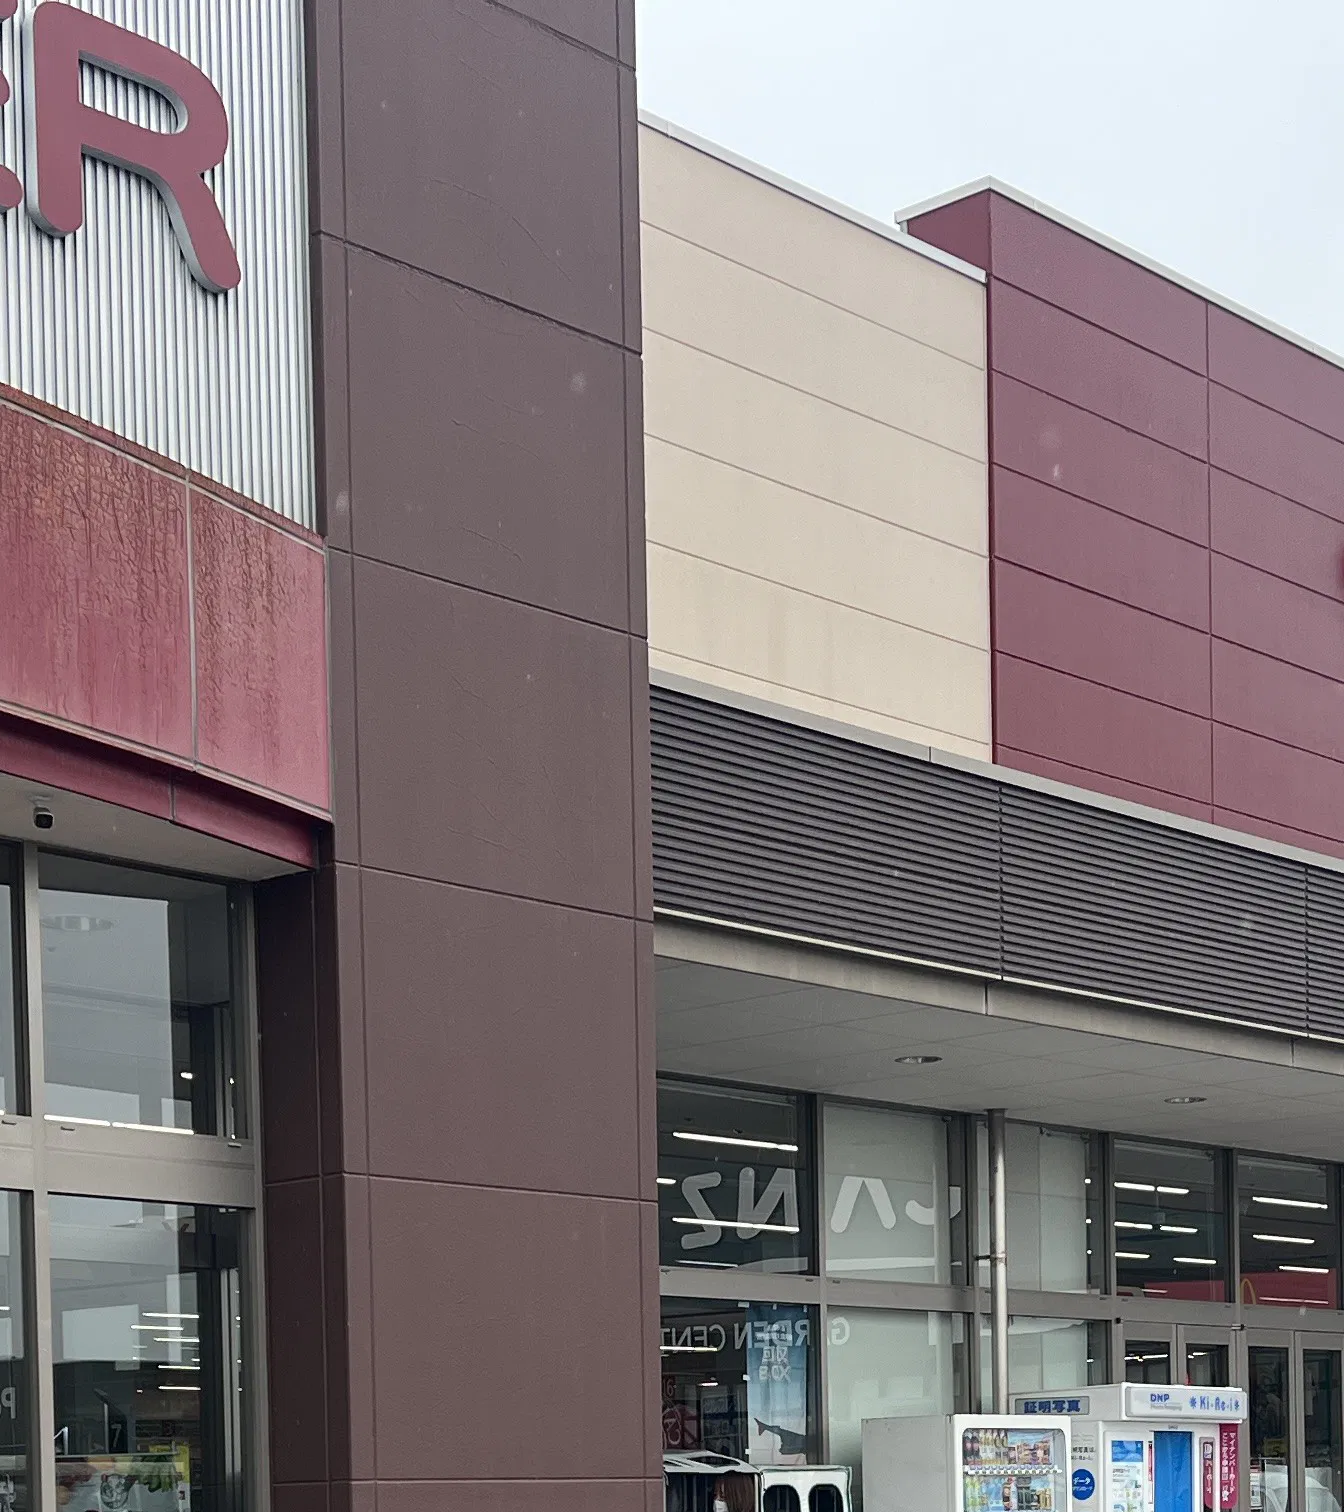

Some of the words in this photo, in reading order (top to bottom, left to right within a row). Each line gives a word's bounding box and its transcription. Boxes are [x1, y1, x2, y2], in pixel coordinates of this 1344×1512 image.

[1150, 1393, 1170, 1403] DNP
[1023, 1399, 1081, 1414] 証明写真
